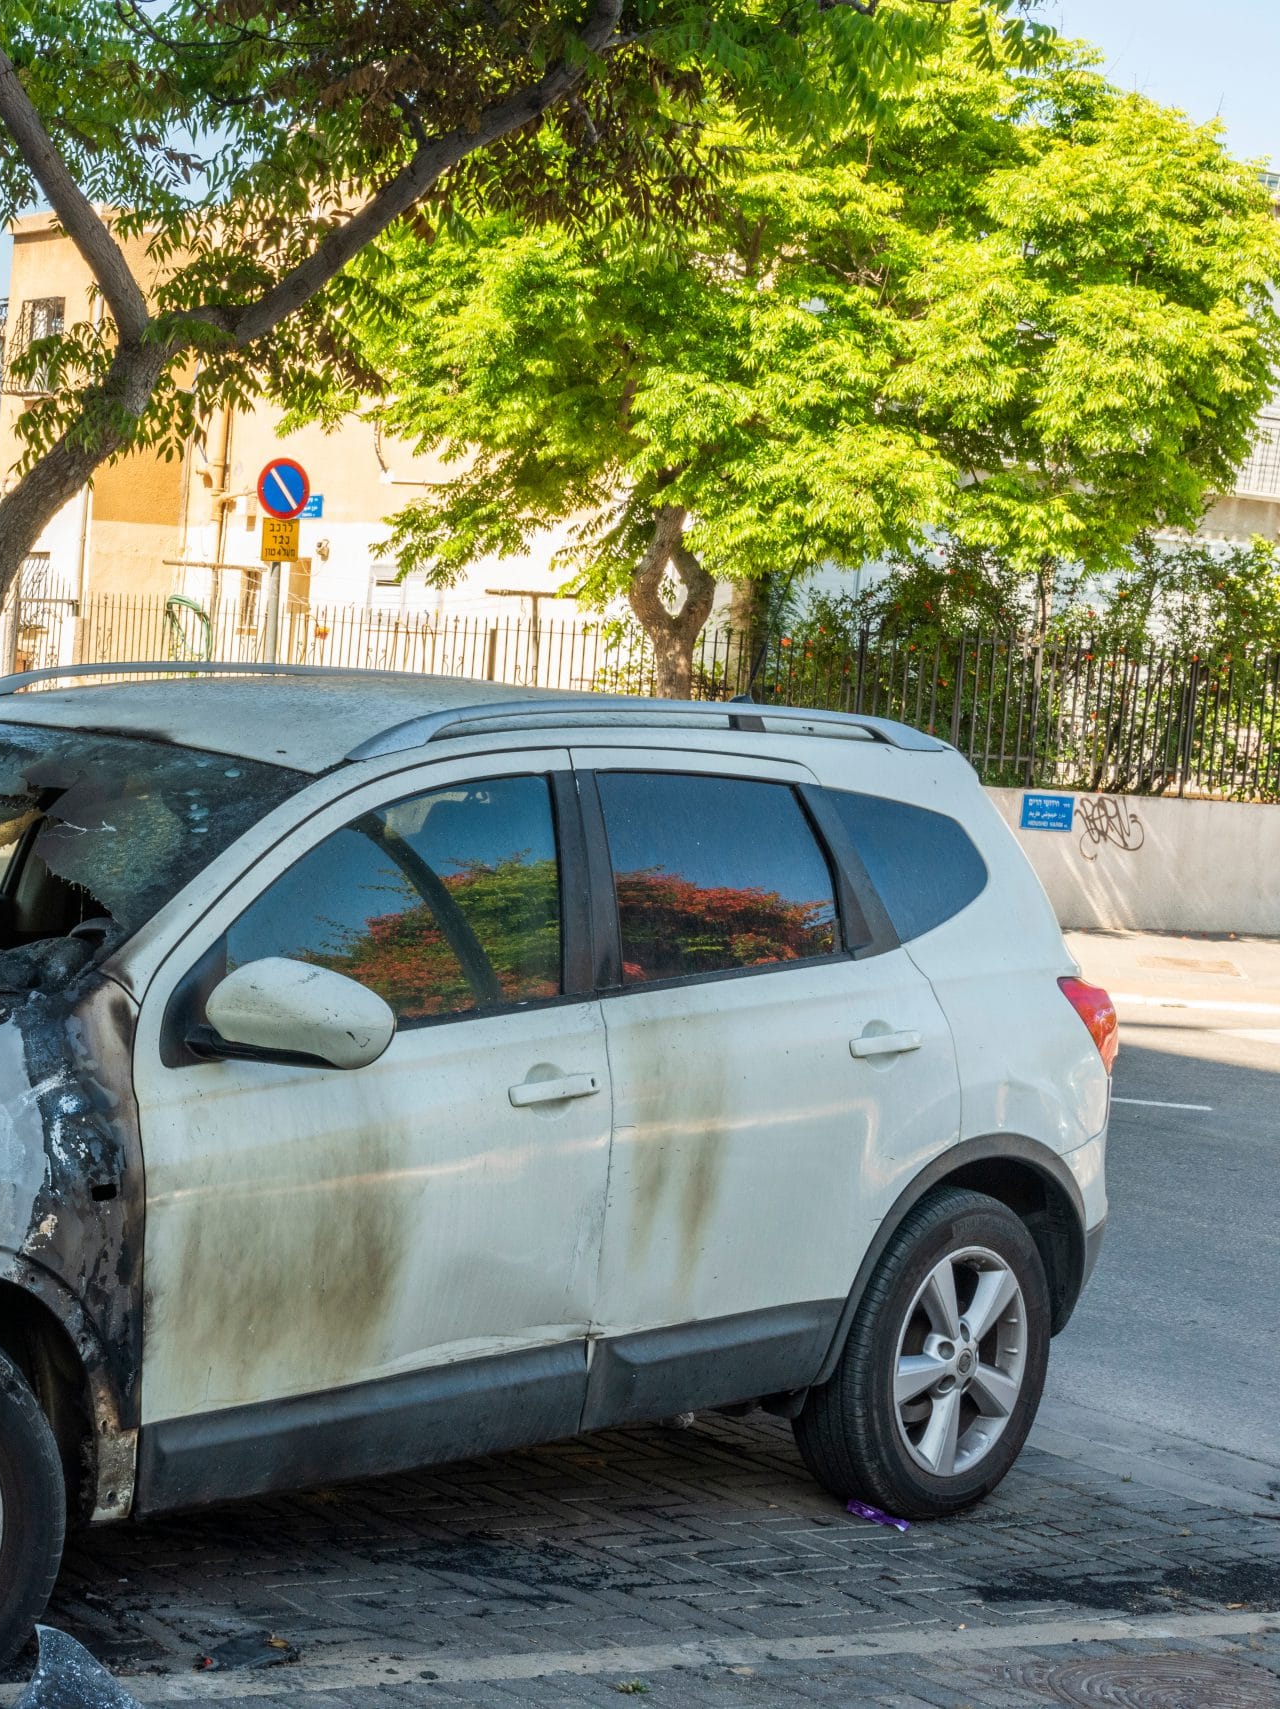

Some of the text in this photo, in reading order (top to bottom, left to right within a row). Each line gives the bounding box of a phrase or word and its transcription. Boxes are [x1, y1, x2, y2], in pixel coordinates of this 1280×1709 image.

[269, 523, 293, 532] לרכב
[272, 535, 290, 545] כבד
[265, 548, 276, 557] טון
